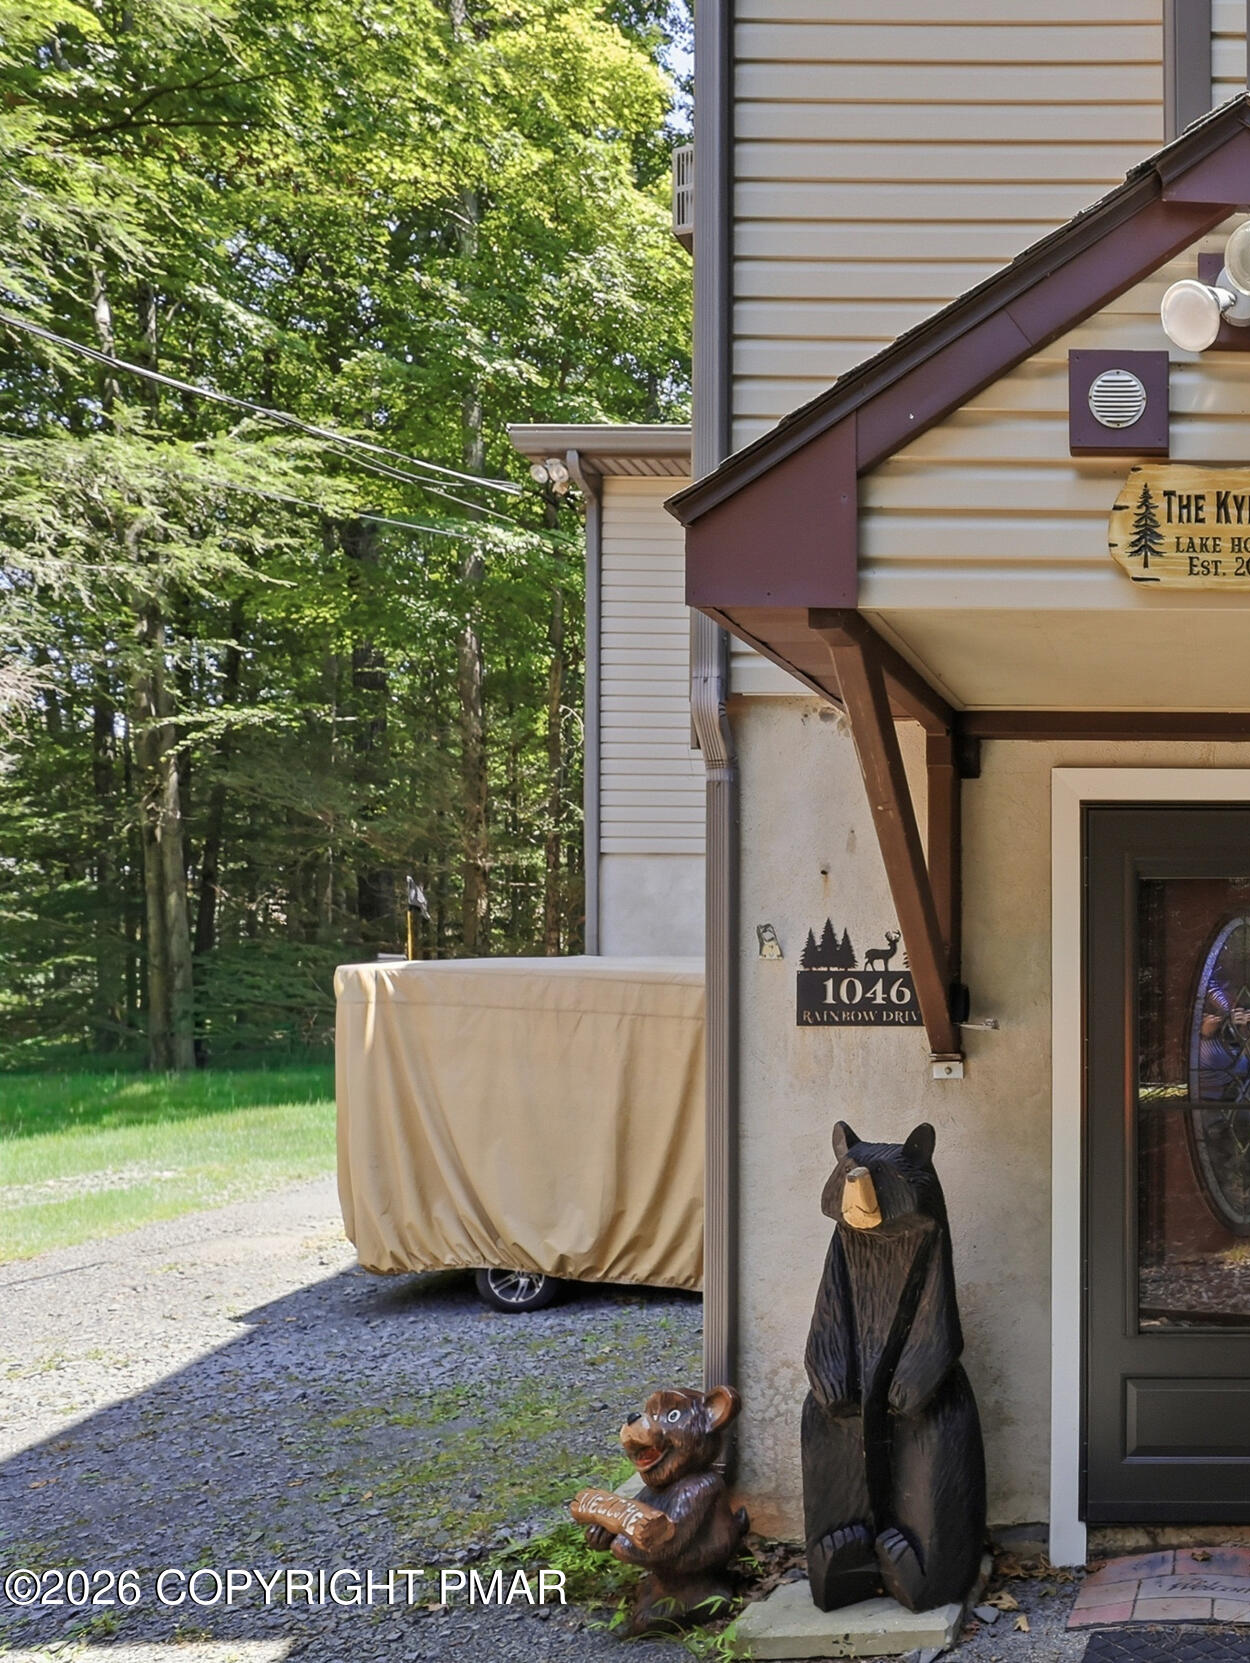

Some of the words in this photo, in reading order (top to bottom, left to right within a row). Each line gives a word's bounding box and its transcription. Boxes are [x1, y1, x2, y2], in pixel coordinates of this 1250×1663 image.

[1163, 490, 1206, 525] THE
[1175, 537, 1222, 553] LAKE
[1188, 556, 1226, 576] EST.
[822, 977, 911, 1004] 1046
[802, 1010, 877, 1023] RAINBOW
[882, 1010, 921, 1024] DRIV
